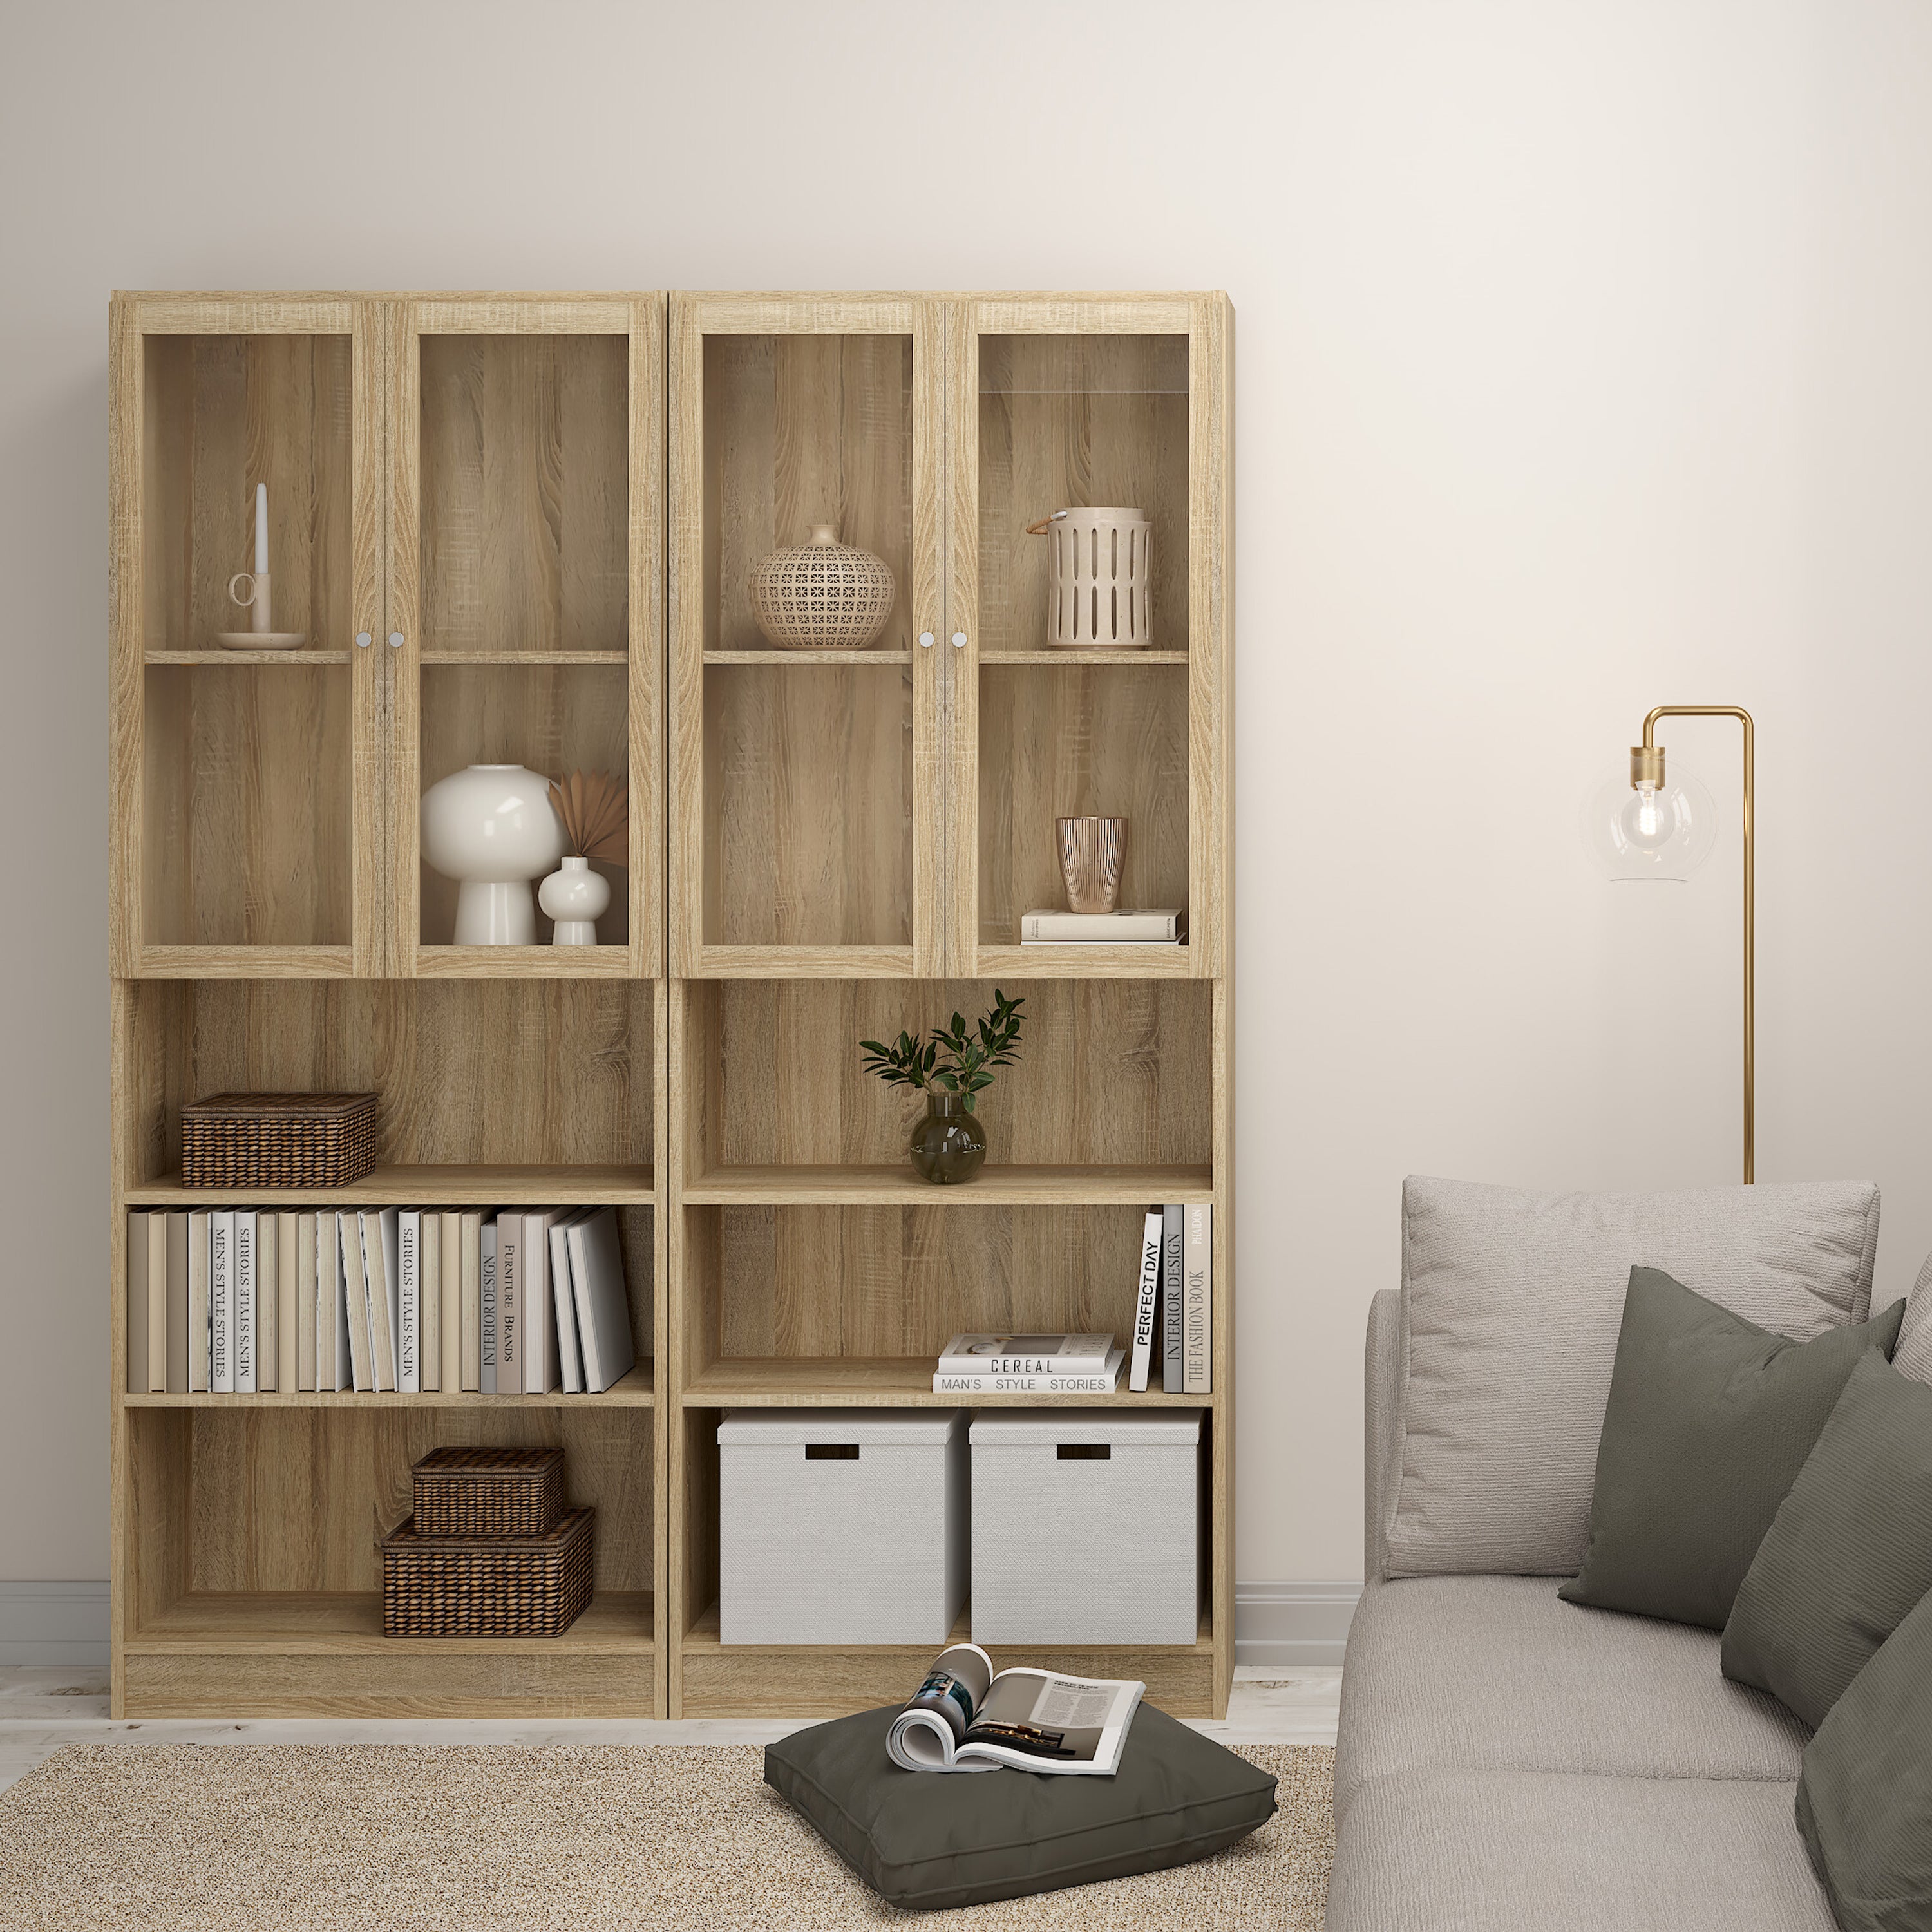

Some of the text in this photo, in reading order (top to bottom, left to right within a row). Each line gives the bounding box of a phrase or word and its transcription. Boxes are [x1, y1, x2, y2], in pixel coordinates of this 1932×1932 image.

[1192, 1209, 1202, 1244] PHAIDON
[216, 1229, 225, 1378] MEN'S STYLE STORIES
[240, 1228, 250, 1376] MEN'S STYLE STORIES
[403, 1228, 413, 1376] MEN'S STYLE STORIES
[484, 1255, 495, 1366] INTERIOR DESIGN
[504, 1245, 515, 1362] FURNITURE BRANDS
[1137, 1241, 1158, 1345] PERFECT DAY
[1167, 1234, 1180, 1360] INTERIOR DESIGN
[1189, 1271, 1204, 1383] THE FASHION BOOK
[942, 1379, 1106, 1390] MAN'S STYLE STORIES
[991, 1359, 1053, 1373] CEREAL
